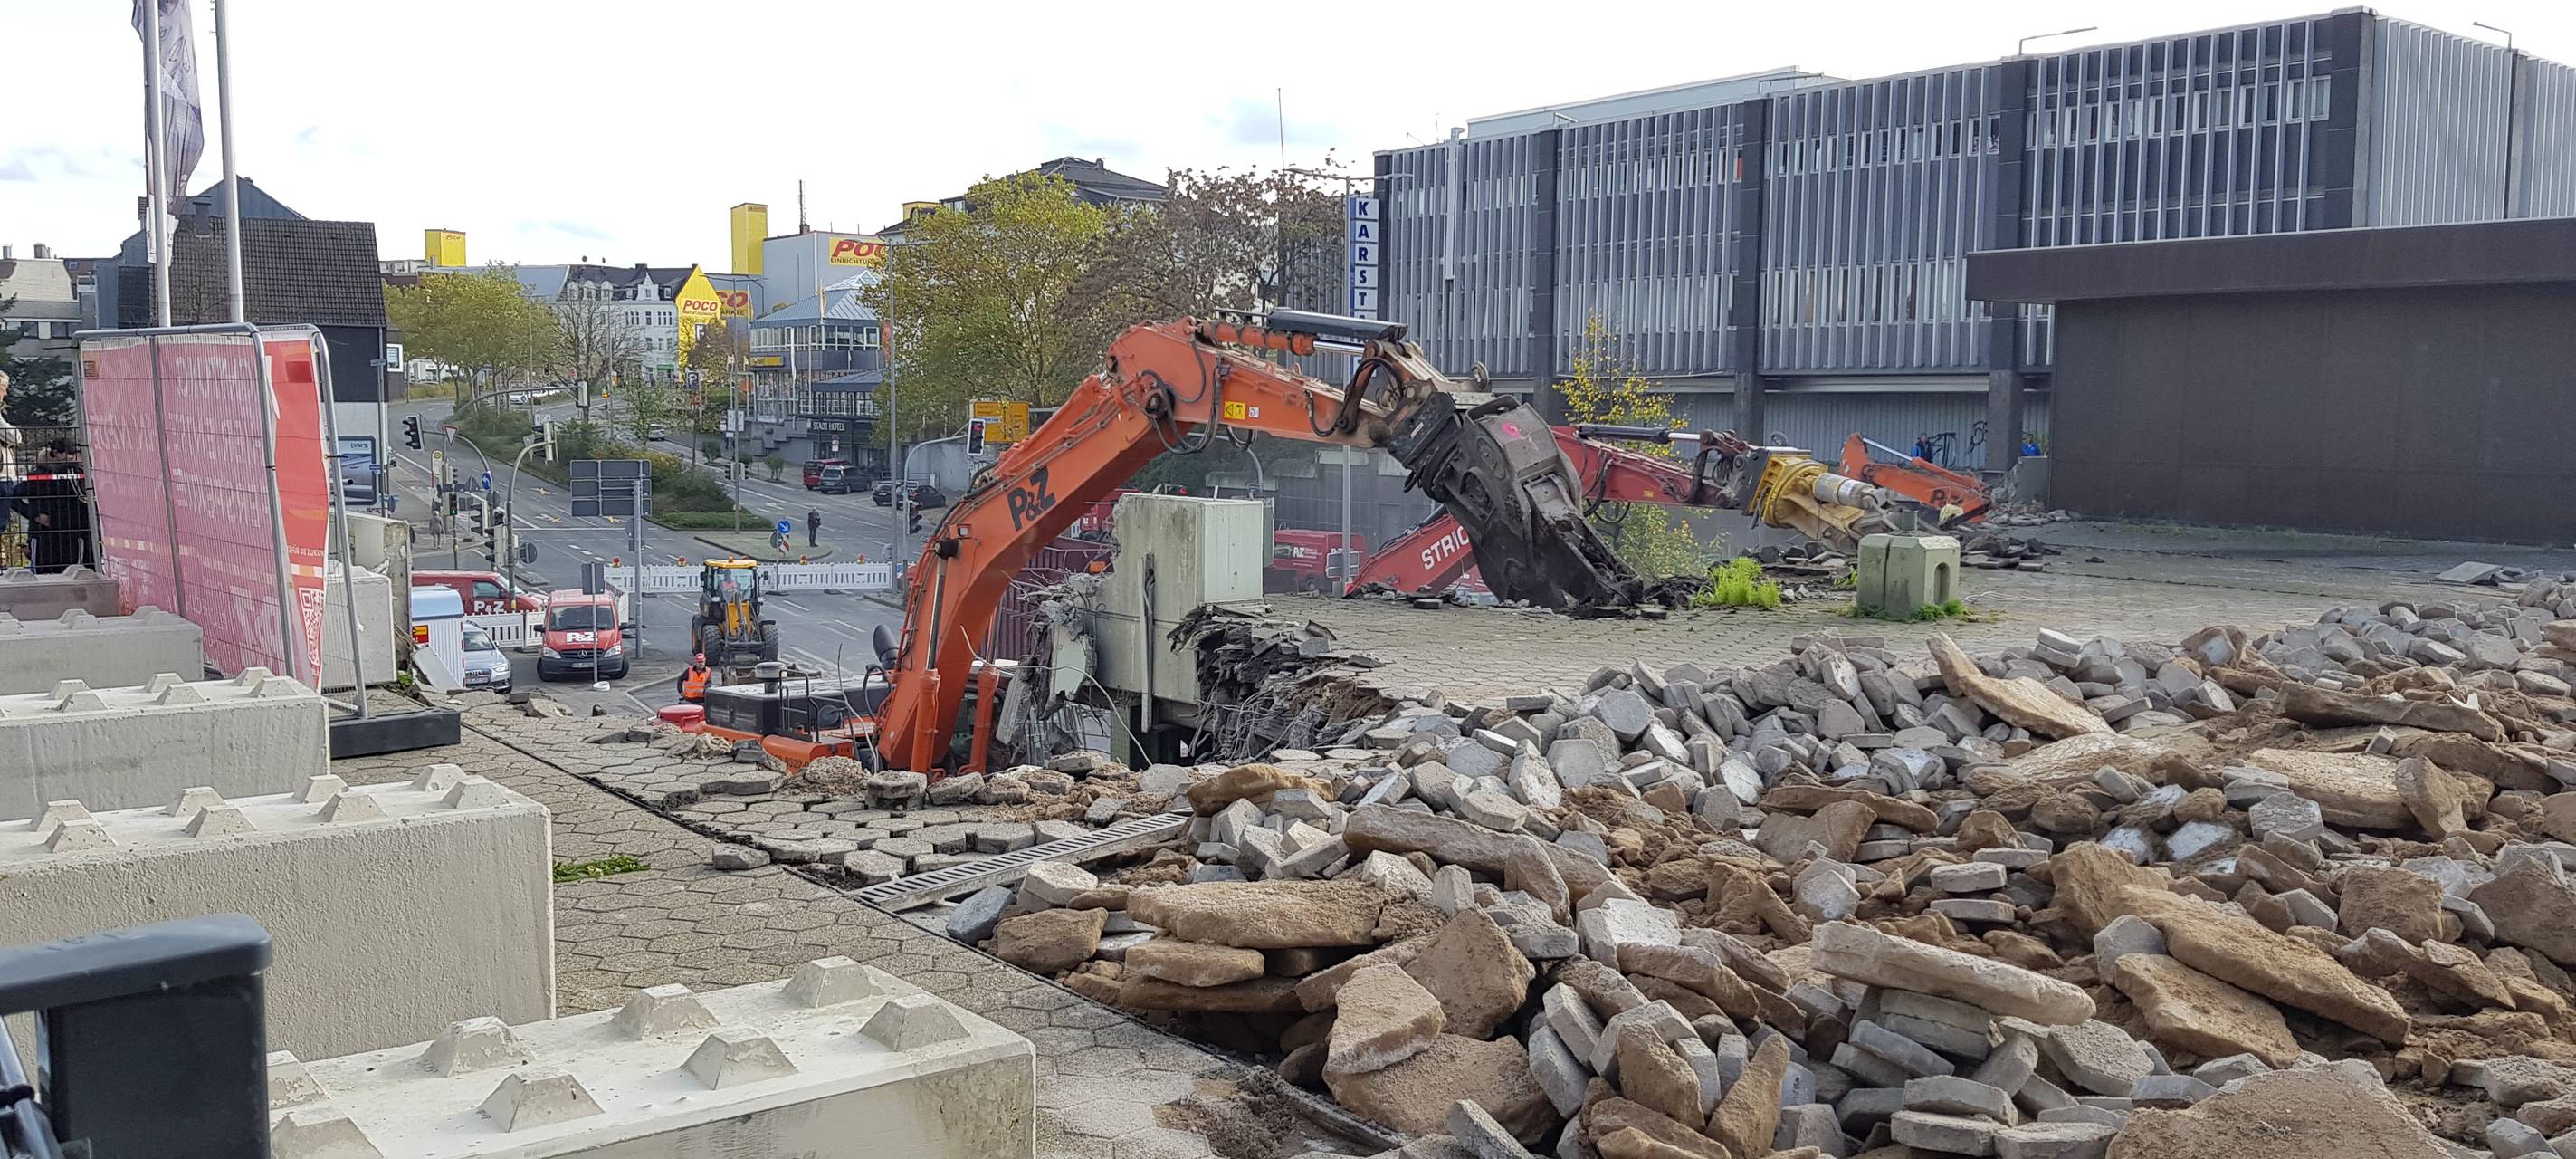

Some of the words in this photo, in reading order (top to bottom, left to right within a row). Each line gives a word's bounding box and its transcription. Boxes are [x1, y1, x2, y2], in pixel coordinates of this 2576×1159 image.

[832, 240, 884, 258] POC
[1358, 200, 1370, 317] KARST
[682, 300, 718, 311] POCO
[829, 422, 845, 431] HOTEL
[1007, 465, 1056, 532] P&Z
[1421, 525, 1470, 570] STRIC
[473, 600, 505, 612] P&Z
[566, 631, 598, 642] P&Z
